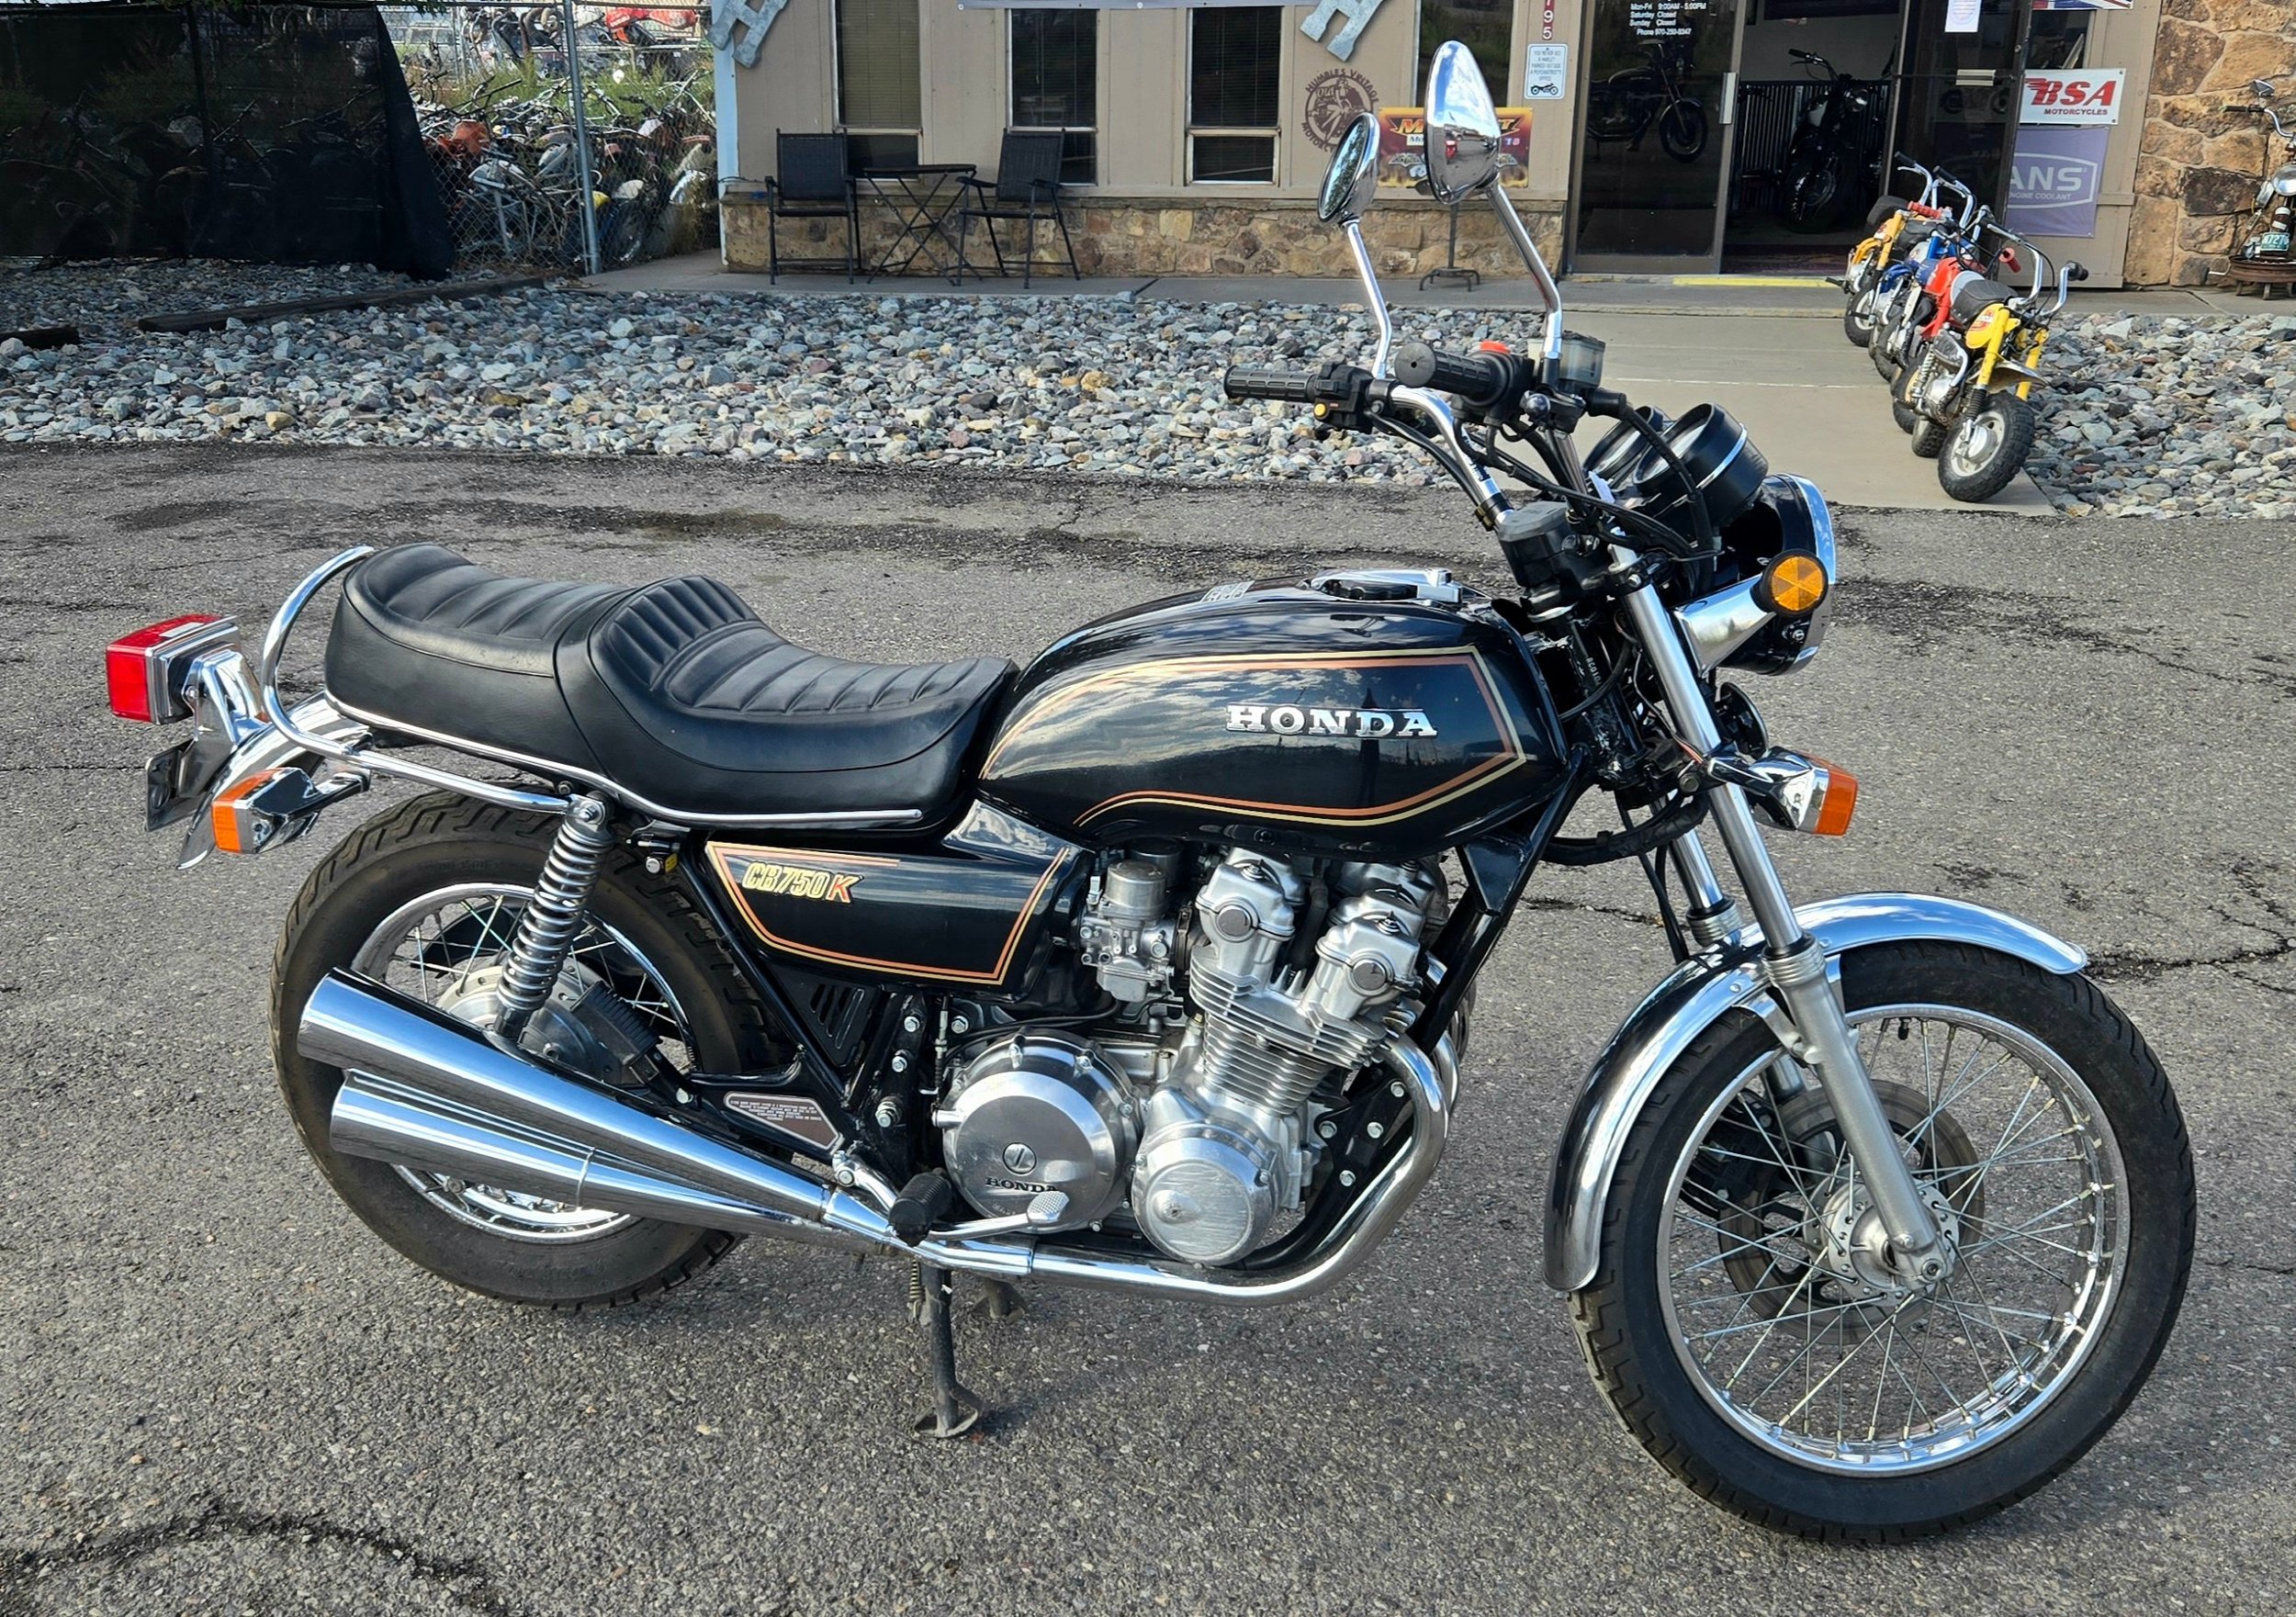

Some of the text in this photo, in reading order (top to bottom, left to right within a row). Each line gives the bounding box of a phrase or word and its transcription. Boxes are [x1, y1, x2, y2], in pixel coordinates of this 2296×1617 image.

[2026, 78, 2116, 106] BSA
[2035, 192, 2072, 200] COOLANT
[1225, 703, 1438, 737] HONDA
[985, 1176, 1061, 1193] HONDA
